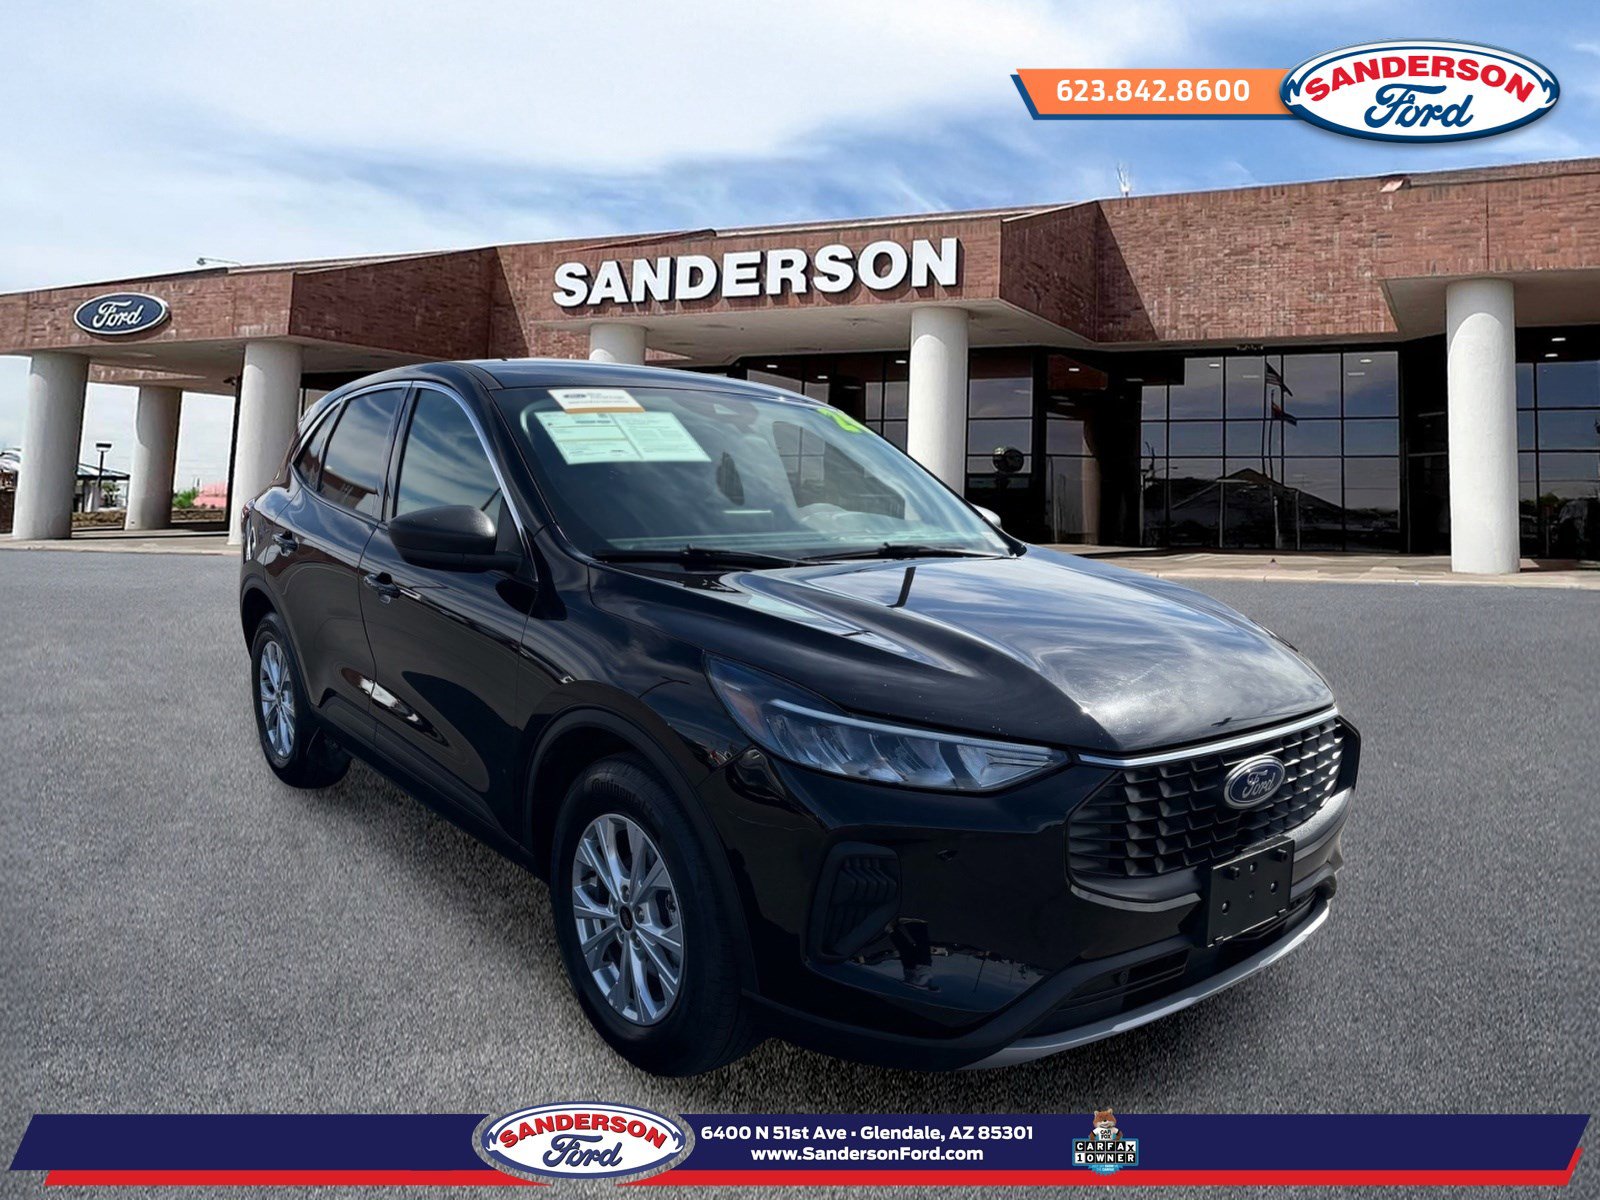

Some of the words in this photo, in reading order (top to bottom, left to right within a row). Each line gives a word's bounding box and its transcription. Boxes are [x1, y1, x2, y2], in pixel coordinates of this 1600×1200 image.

[552, 237, 959, 308] SANDERSON
[92, 300, 144, 328] Ford
[1242, 769, 1276, 799] Ford
